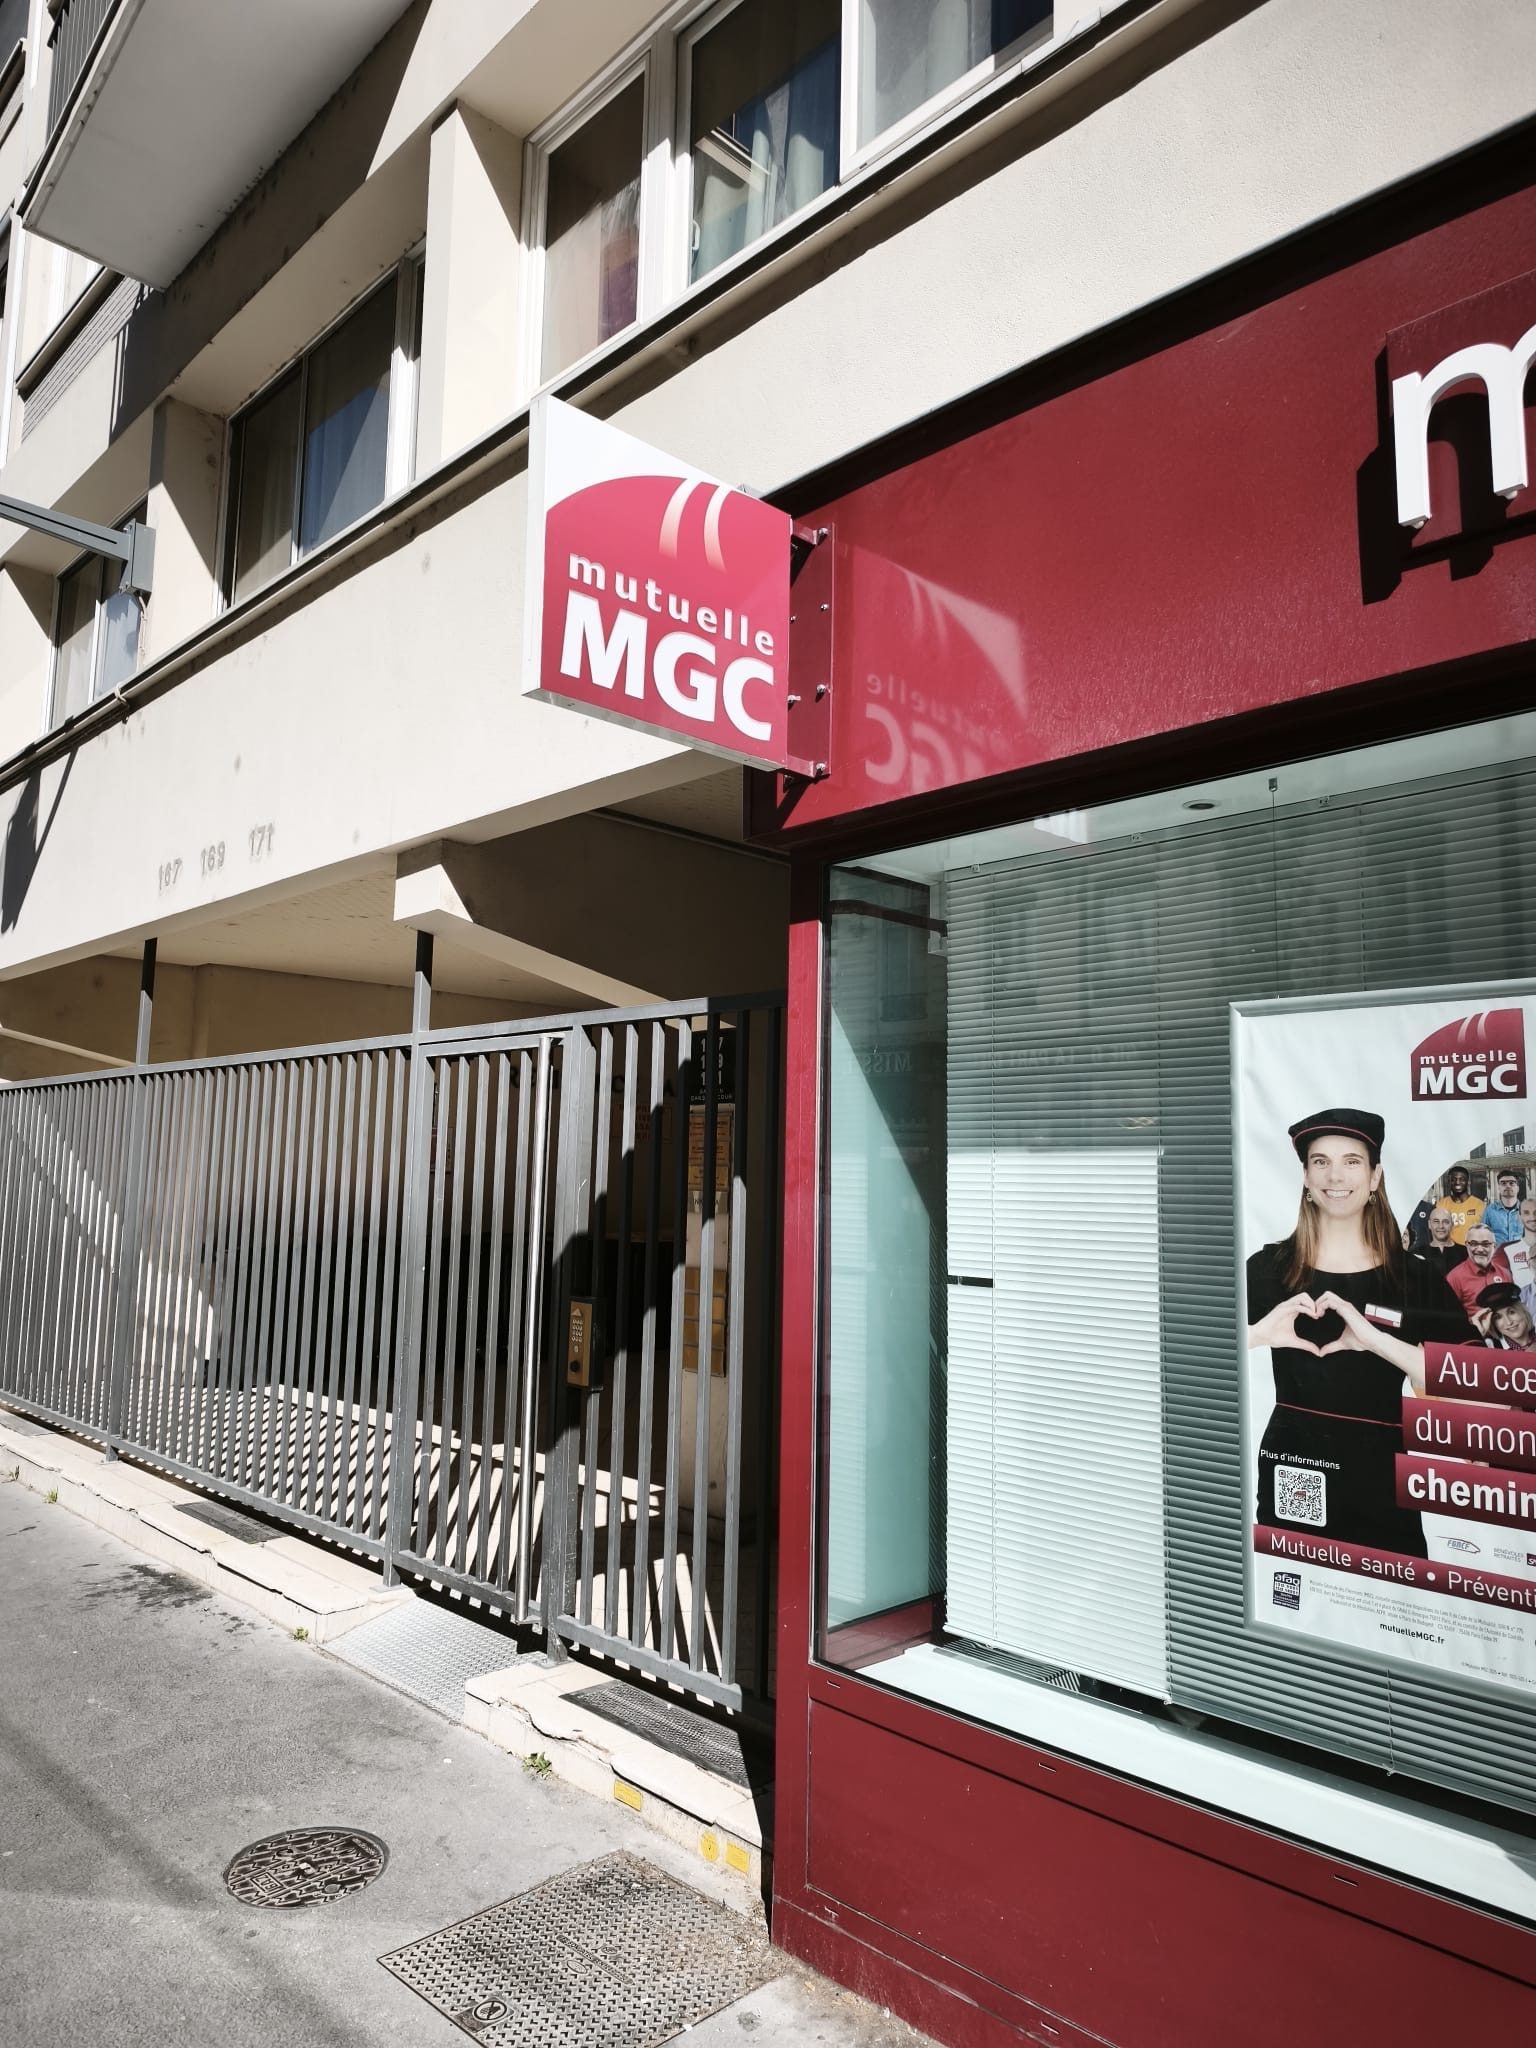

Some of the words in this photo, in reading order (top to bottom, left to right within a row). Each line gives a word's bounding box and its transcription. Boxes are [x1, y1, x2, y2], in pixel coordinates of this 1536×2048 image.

[569, 552, 774, 656] mutuelle
[560, 589, 774, 742] MGC
[159, 857, 183, 892] 167
[201, 840, 226, 877] 169
[249, 822, 275, 858] 171
[1420, 1049, 1517, 1065] mutuelle
[1418, 1063, 1518, 1095] MGC
[1451, 1212, 1466, 1226] 23
[1438, 1351, 1479, 1388] Au
[1416, 1409, 1451, 1445] du
[1466, 1423, 1536, 1457] mon
[1260, 1449, 1279, 1460] Plus
[1280, 1453, 1341, 1470] d'informations
[1407, 1468, 1536, 1520] chemin
[1271, 1533, 1352, 1567] Mutuelle
[1361, 1557, 1416, 1581] santé
[1379, 1621, 1445, 1645] mutuelleMGC.fr
